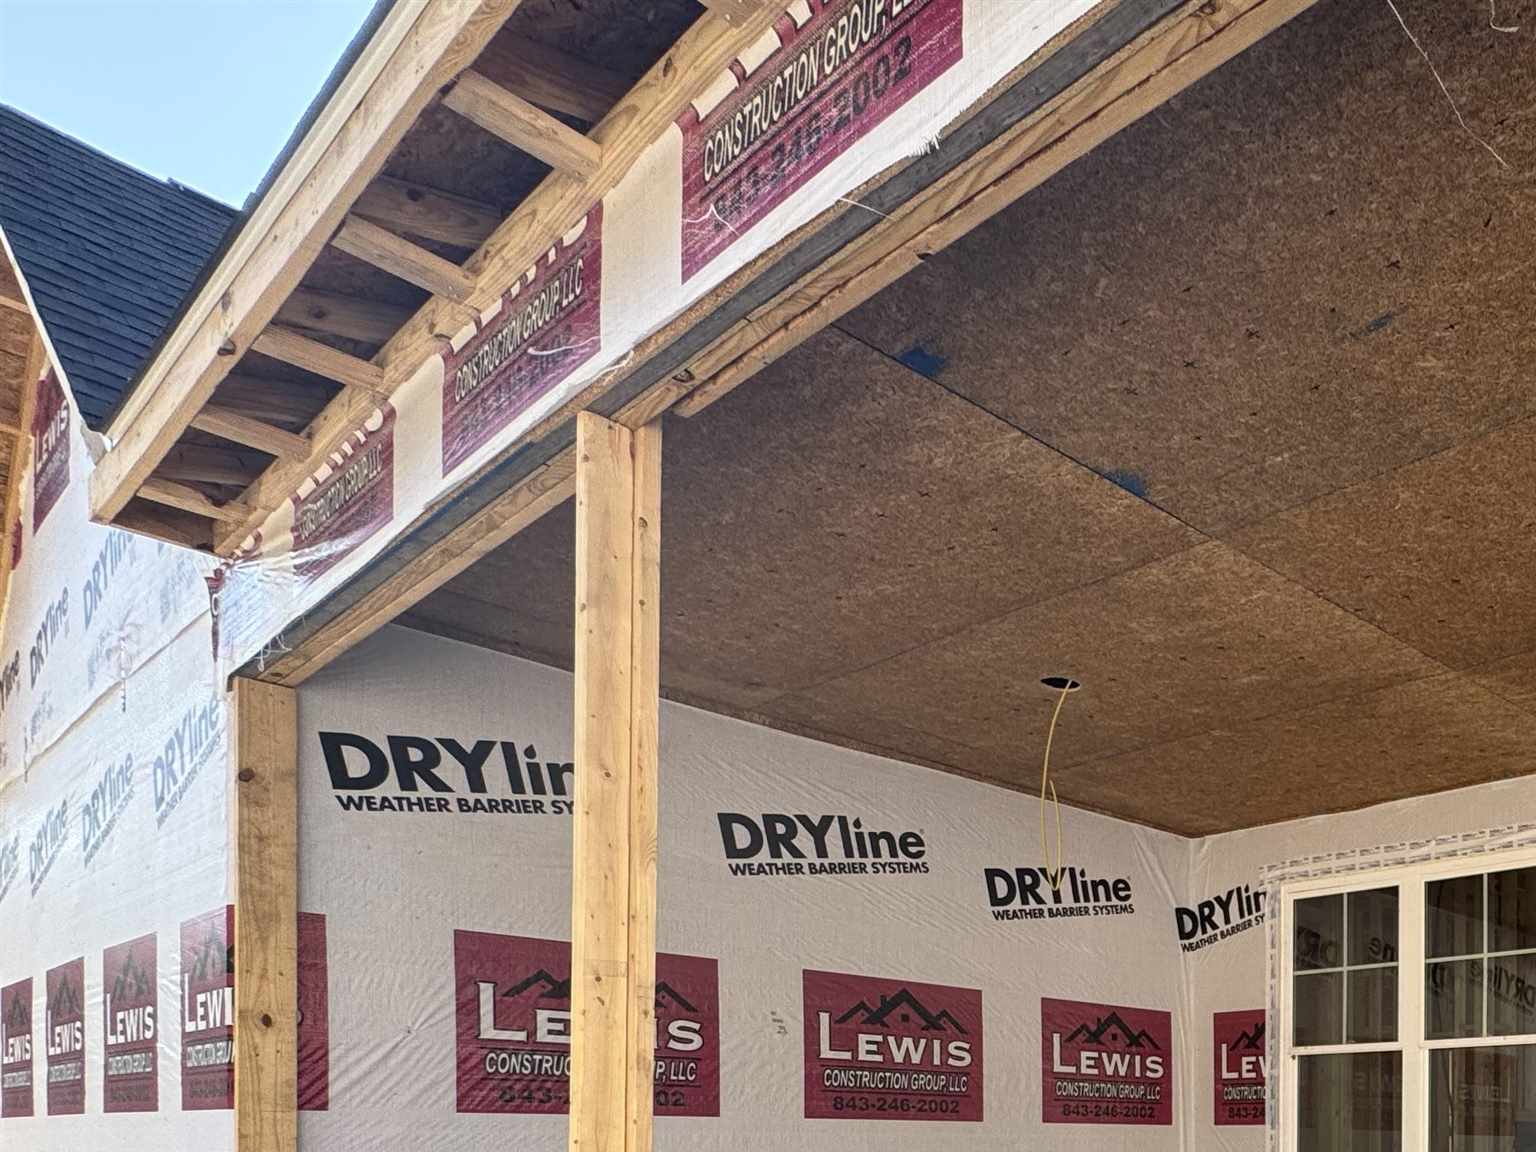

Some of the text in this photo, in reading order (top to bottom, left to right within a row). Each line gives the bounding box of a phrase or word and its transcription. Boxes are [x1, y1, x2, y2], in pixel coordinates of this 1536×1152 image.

[703, 40, 822, 182] CONSTRUCTION
[318, 731, 575, 796] DRYlin
[335, 794, 454, 813] WEATHER
[458, 797, 547, 815] BARRIER
[717, 812, 926, 860] DRYline
[728, 861, 930, 876] WEATHER BARRIER SYSTEMS
[984, 867, 1133, 907] DRYline
[992, 903, 1135, 921] WEATHER BARRIER SYSTEMS
[1174, 884, 1267, 941] DRYlin
[1180, 932, 1219, 954] WEATHER
[1219, 918, 1254, 941] BARRIER
[47, 1010, 83, 1057] LEWIS
[105, 992, 155, 1046] LEWIS
[2, 1022, 32, 1065] LEWIS
[818, 1010, 973, 1068] LEWIS
[1051, 1032, 1166, 1079] LEWIS
[671, 1062, 697, 1082] LLC
[823, 1068, 968, 1093] CONSTRUCTION GROUP, LLC
[1056, 1081, 1118, 1099] CONSTRUCTION
[1146, 1084, 1161, 1100] LLC
[831, 1095, 960, 1114] 843-246-2002
[1062, 1103, 1156, 1119] 843-246-2002
[1224, 1087, 1267, 1100] CONSTRUCTIO
